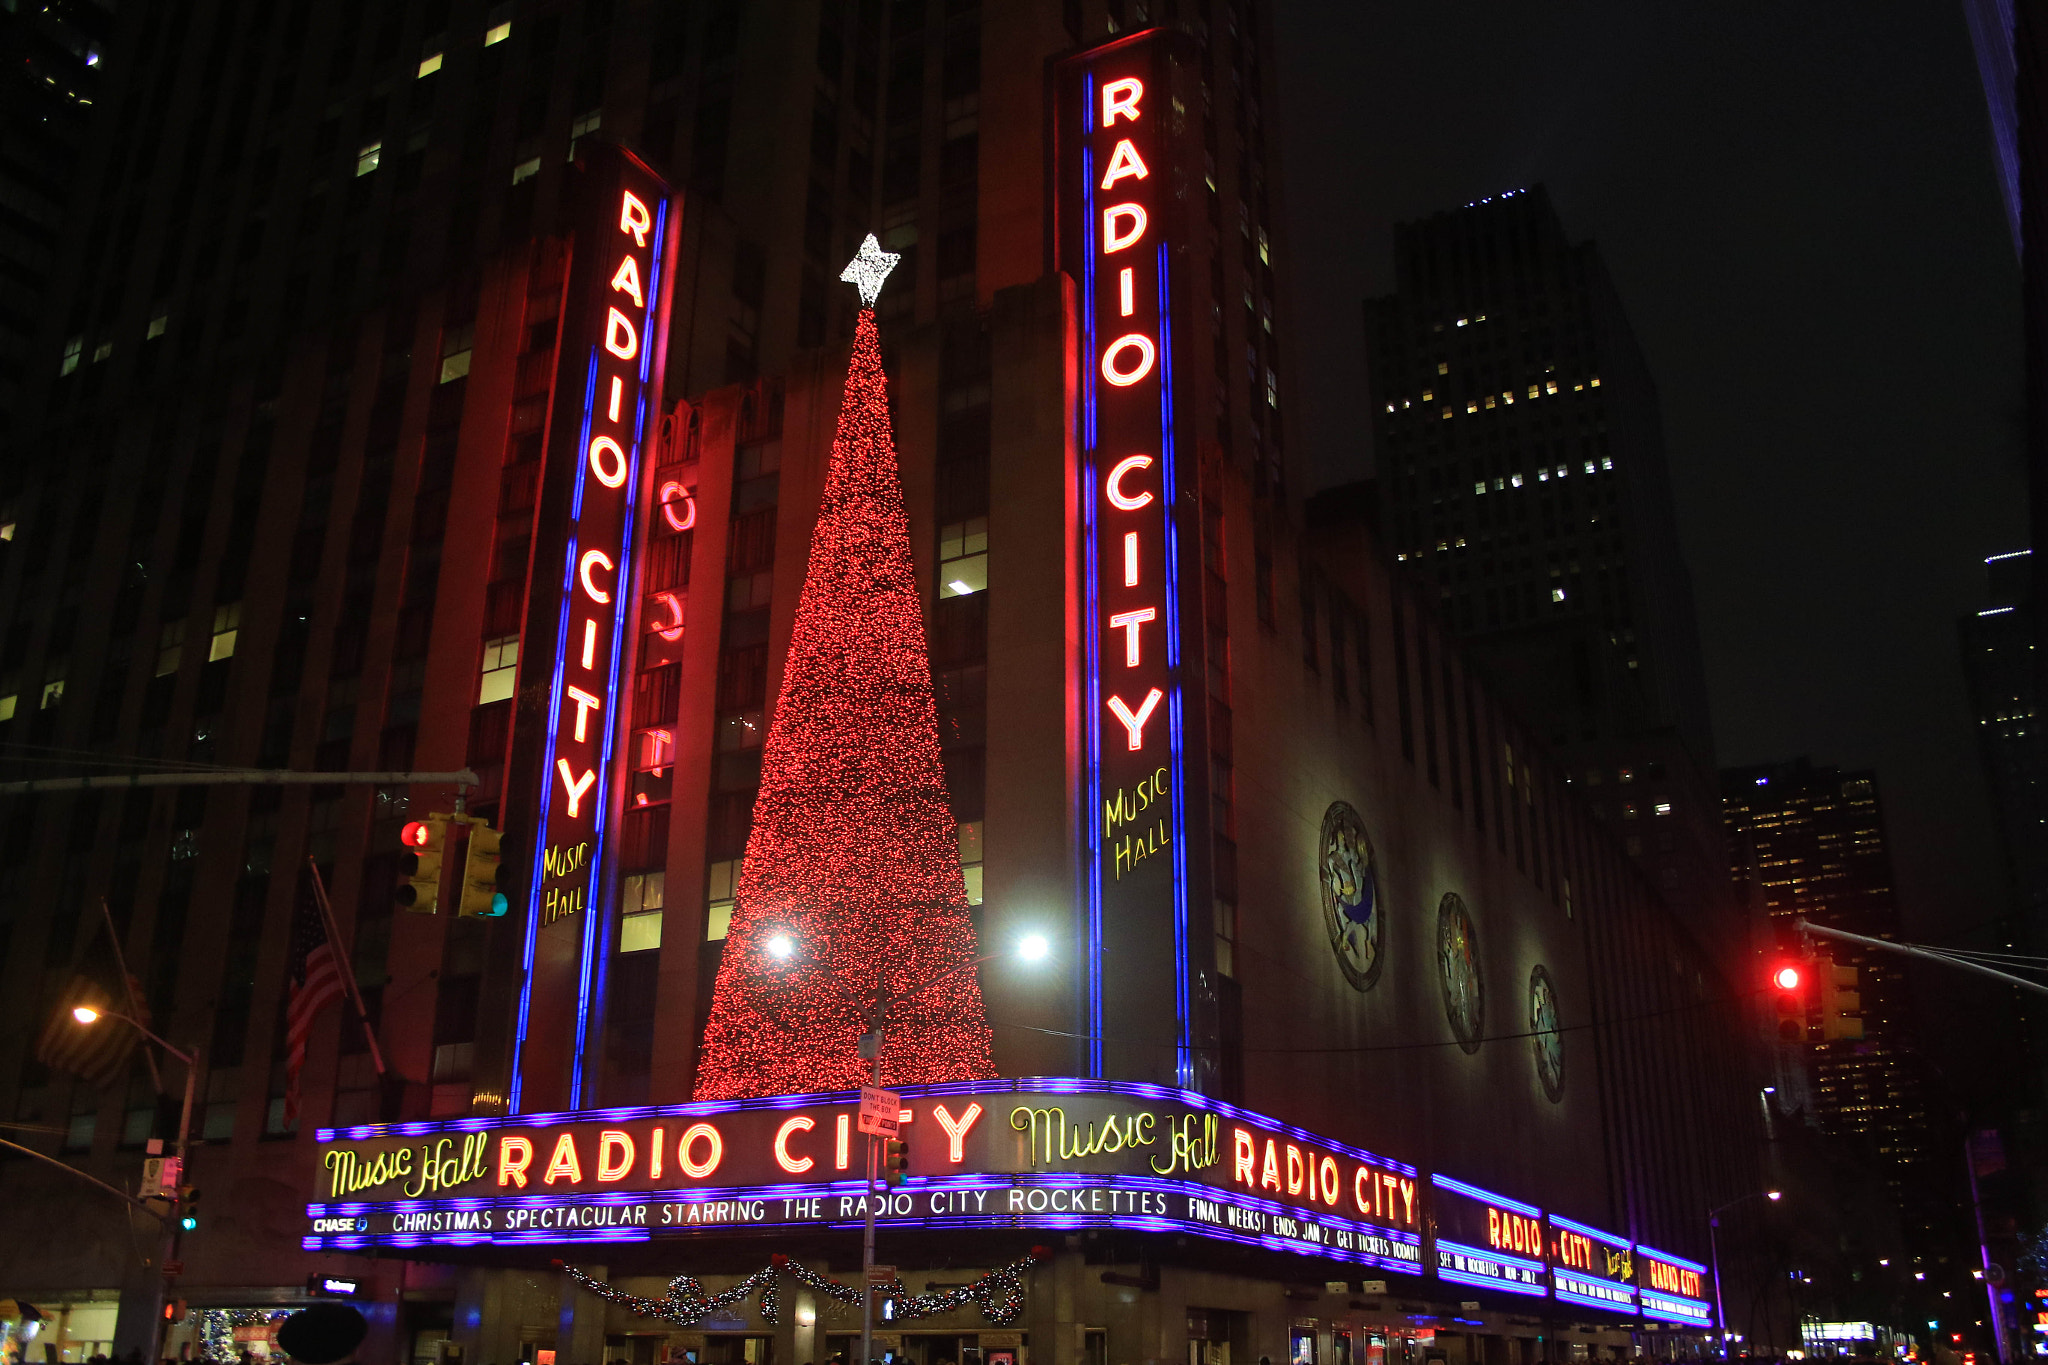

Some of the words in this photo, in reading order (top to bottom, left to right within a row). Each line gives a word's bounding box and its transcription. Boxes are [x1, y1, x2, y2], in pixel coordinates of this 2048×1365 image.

[1101, 77, 1155, 387] RADIO
[589, 189, 651, 488] RADIO
[1106, 455, 1163, 752] CITY
[556, 549, 614, 819] CITY
[870, 1103, 880, 1111] THE
[881, 1105, 892, 1113] BOX
[881, 1096, 897, 1106] BLOCK
[325, 1148, 412, 1198] Music
[404, 1131, 488, 1198] Hall
[498, 1123, 722, 1188] RADIO
[774, 1102, 983, 1173] CIY
[1010, 1106, 1156, 1167] Music
[1151, 1113, 1220, 1175] Hall
[1234, 1128, 1340, 1206] RADIO
[1355, 1166, 1414, 1224] CITY
[313, 1218, 356, 1232] CHASE
[392, 1210, 492, 1232] CHRISTMAS
[505, 1205, 648, 1229] SPECTACULAR
[661, 1199, 765, 1224] STARRING
[783, 1197, 822, 1219] THE
[930, 1190, 988, 1214] CITY
[1008, 1189, 1167, 1214] ROCKETTES
[1189, 1197, 1222, 1224] FINAL
[1227, 1206, 1266, 1232] WEEKS!
[1273, 1216, 1298, 1238] ENDS
[1302, 1223, 1320, 1243] JAN
[1323, 1227, 1330, 1245] 2
[1337, 1230, 1353, 1249] GET
[1357, 1234, 1389, 1256] TICKETS
[1392, 1241, 1419, 1262] TODAY!
[1488, 1207, 1541, 1257] RADIO
[1440, 1252, 1451, 1268] SEE
[1532, 1271, 1537, 1285] 2
[1560, 1230, 1591, 1270] CITY
[1650, 1259, 1679, 1293] RADIO
[1680, 1269, 1700, 1298] CITY
